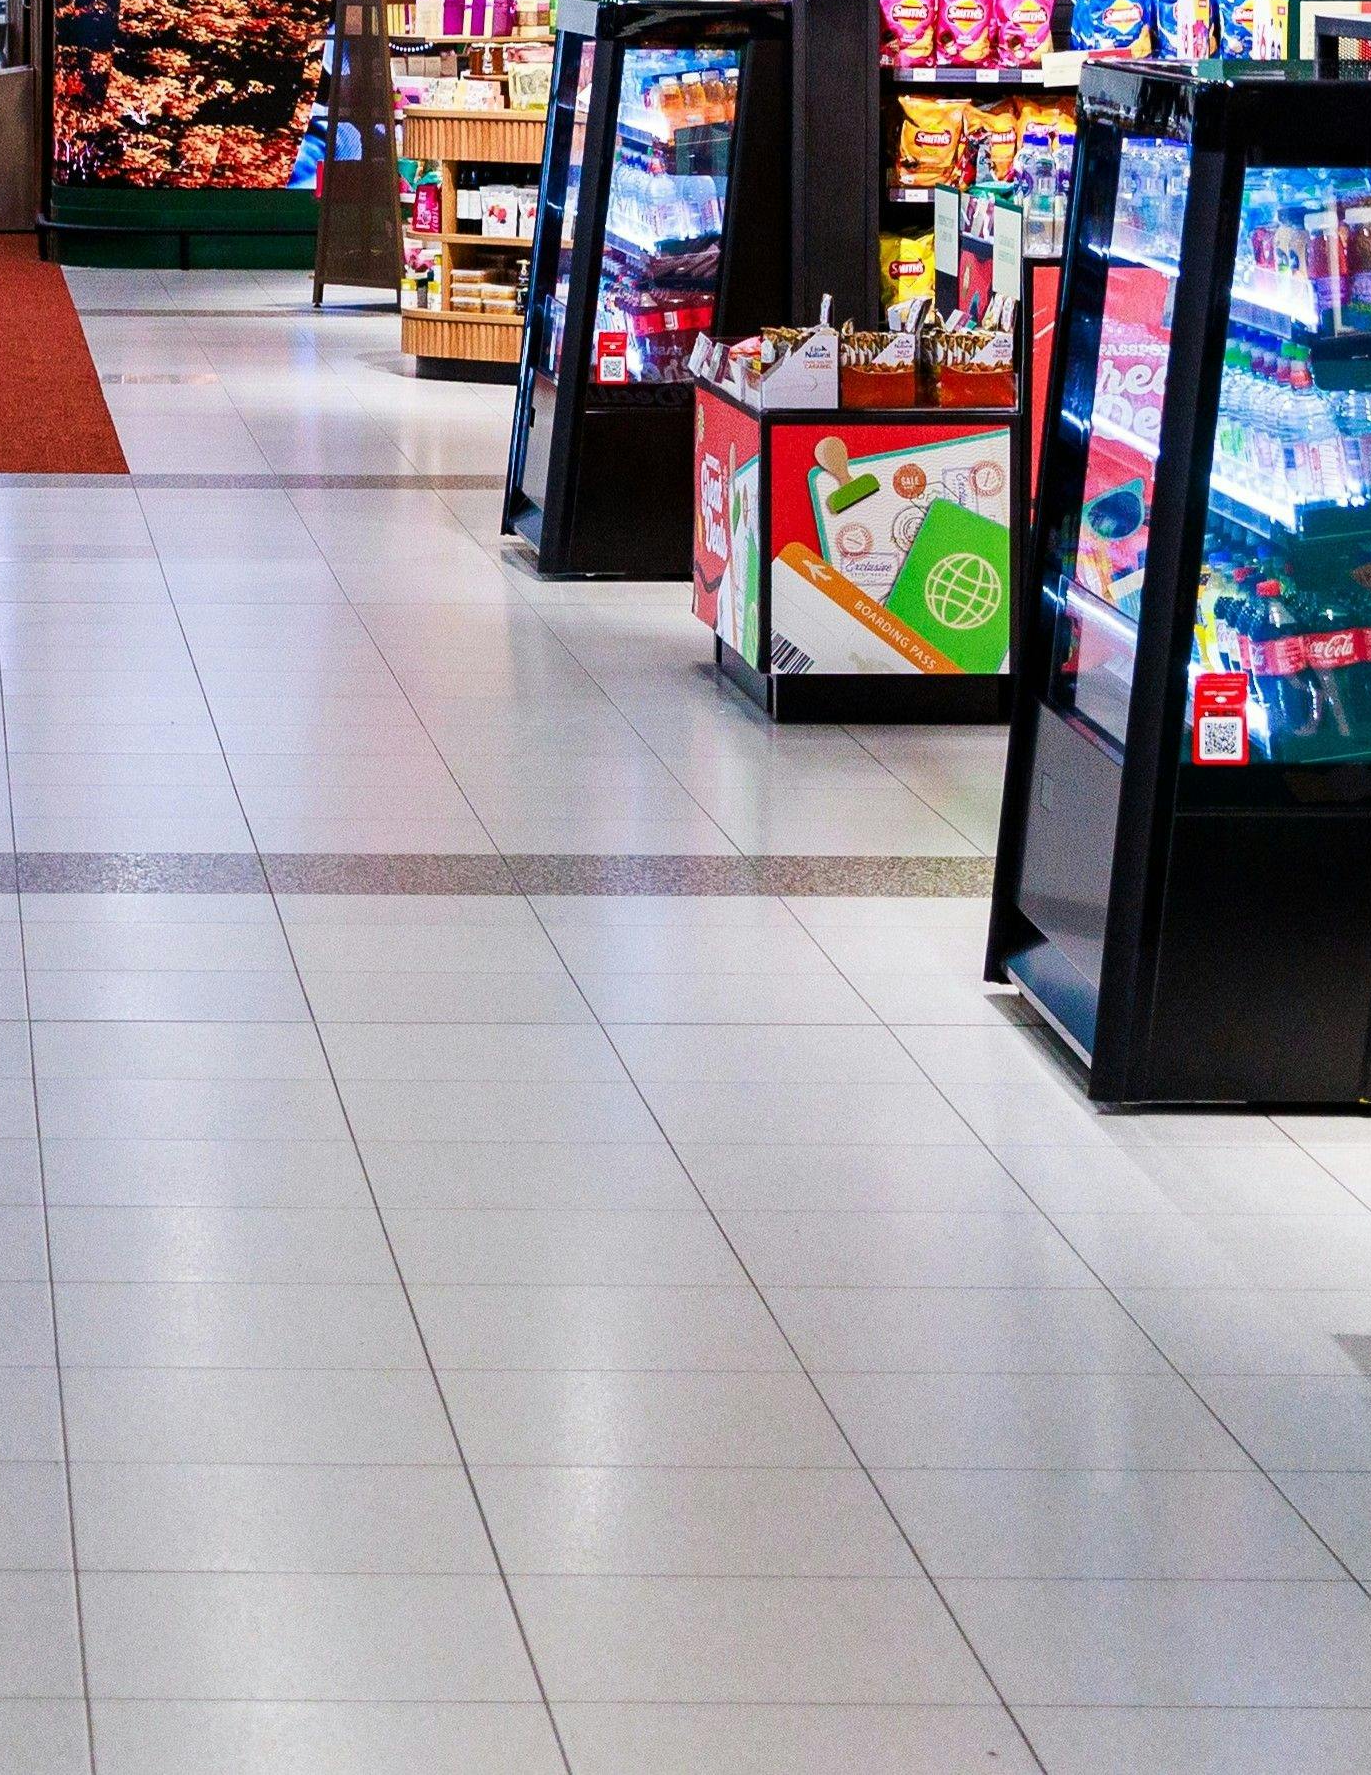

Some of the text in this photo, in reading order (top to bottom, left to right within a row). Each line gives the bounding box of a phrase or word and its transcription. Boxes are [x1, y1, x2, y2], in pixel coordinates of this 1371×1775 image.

[900, 475, 920, 487] SALE
[845, 559, 892, 575] Exclusive
[853, 599, 938, 672] BOARDING PASS
